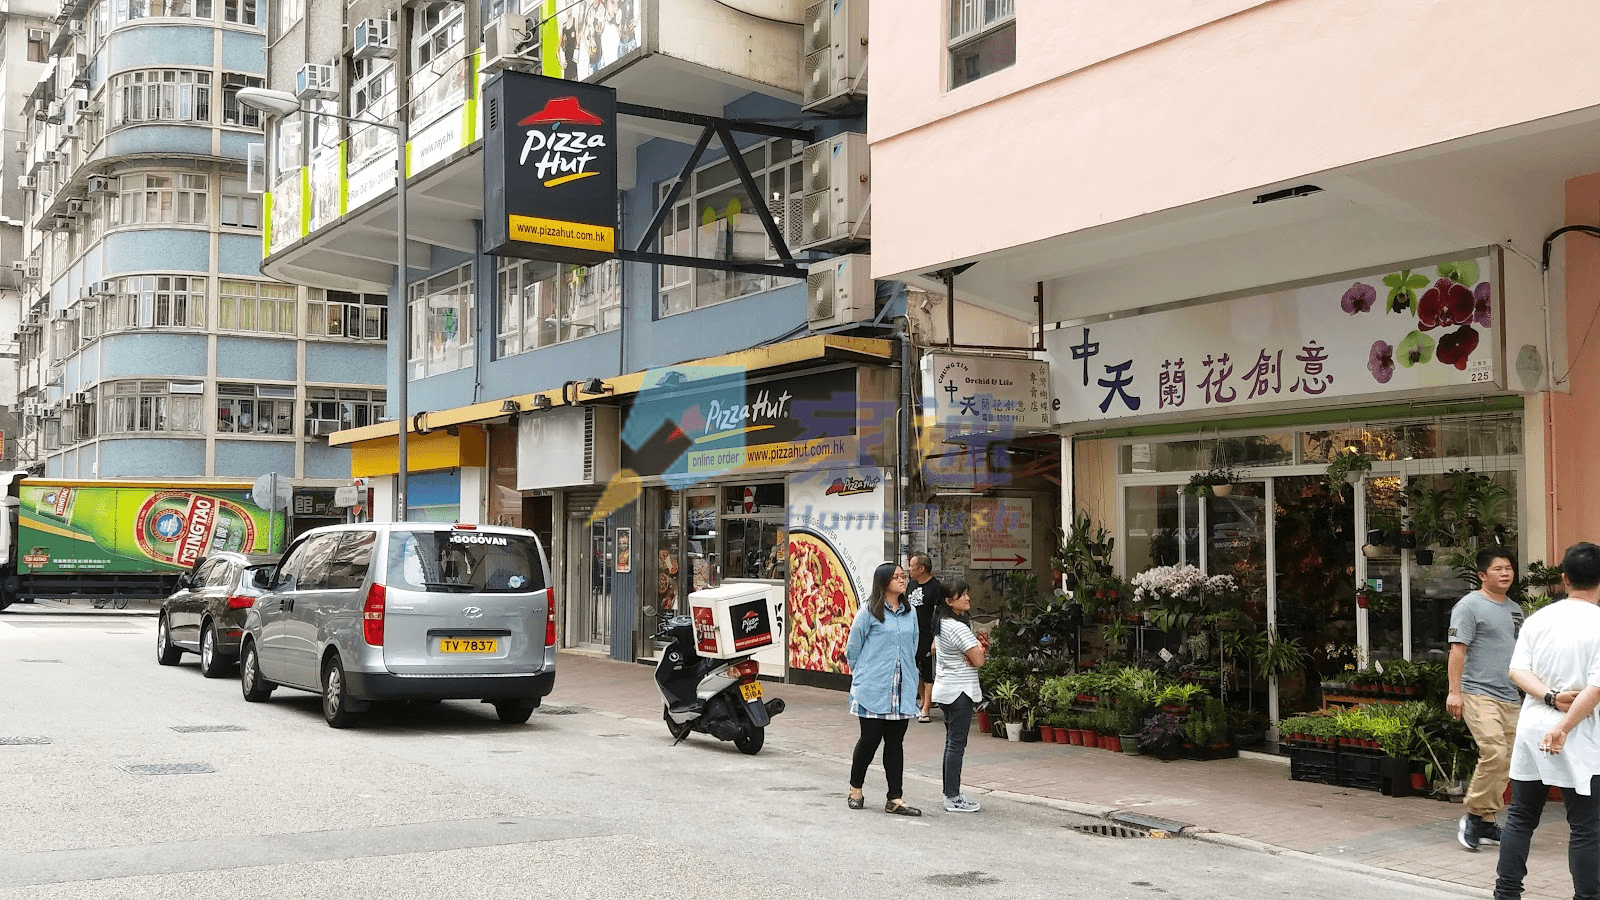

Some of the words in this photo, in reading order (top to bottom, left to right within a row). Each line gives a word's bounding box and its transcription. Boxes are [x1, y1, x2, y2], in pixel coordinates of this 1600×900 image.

[519, 122, 607, 165] Pizza
[534, 150, 598, 179] Hut
[516, 222, 605, 242] www.pizzahut.com.hk
[938, 362, 955, 384] CHUNG
[965, 377, 990, 385] Orchid
[991, 378, 998, 386] &
[1471, 371, 1489, 382] 225
[704, 398, 751, 434] Pizza
[692, 454, 715, 467] online
[717, 451, 740, 465] order
[747, 439, 845, 463] www.pizzahut.com.hk
[843, 476, 863, 492] Pizza
[180, 499, 212, 563] TSINGTAO
[801, 515, 820, 528] VEGGIE
[821, 525, 838, 542] LOVER
[842, 547, 857, 573] SUPER
[741, 617, 760, 630] Pizza
[444, 641, 460, 651] TV
[462, 640, 494, 651] 7837
